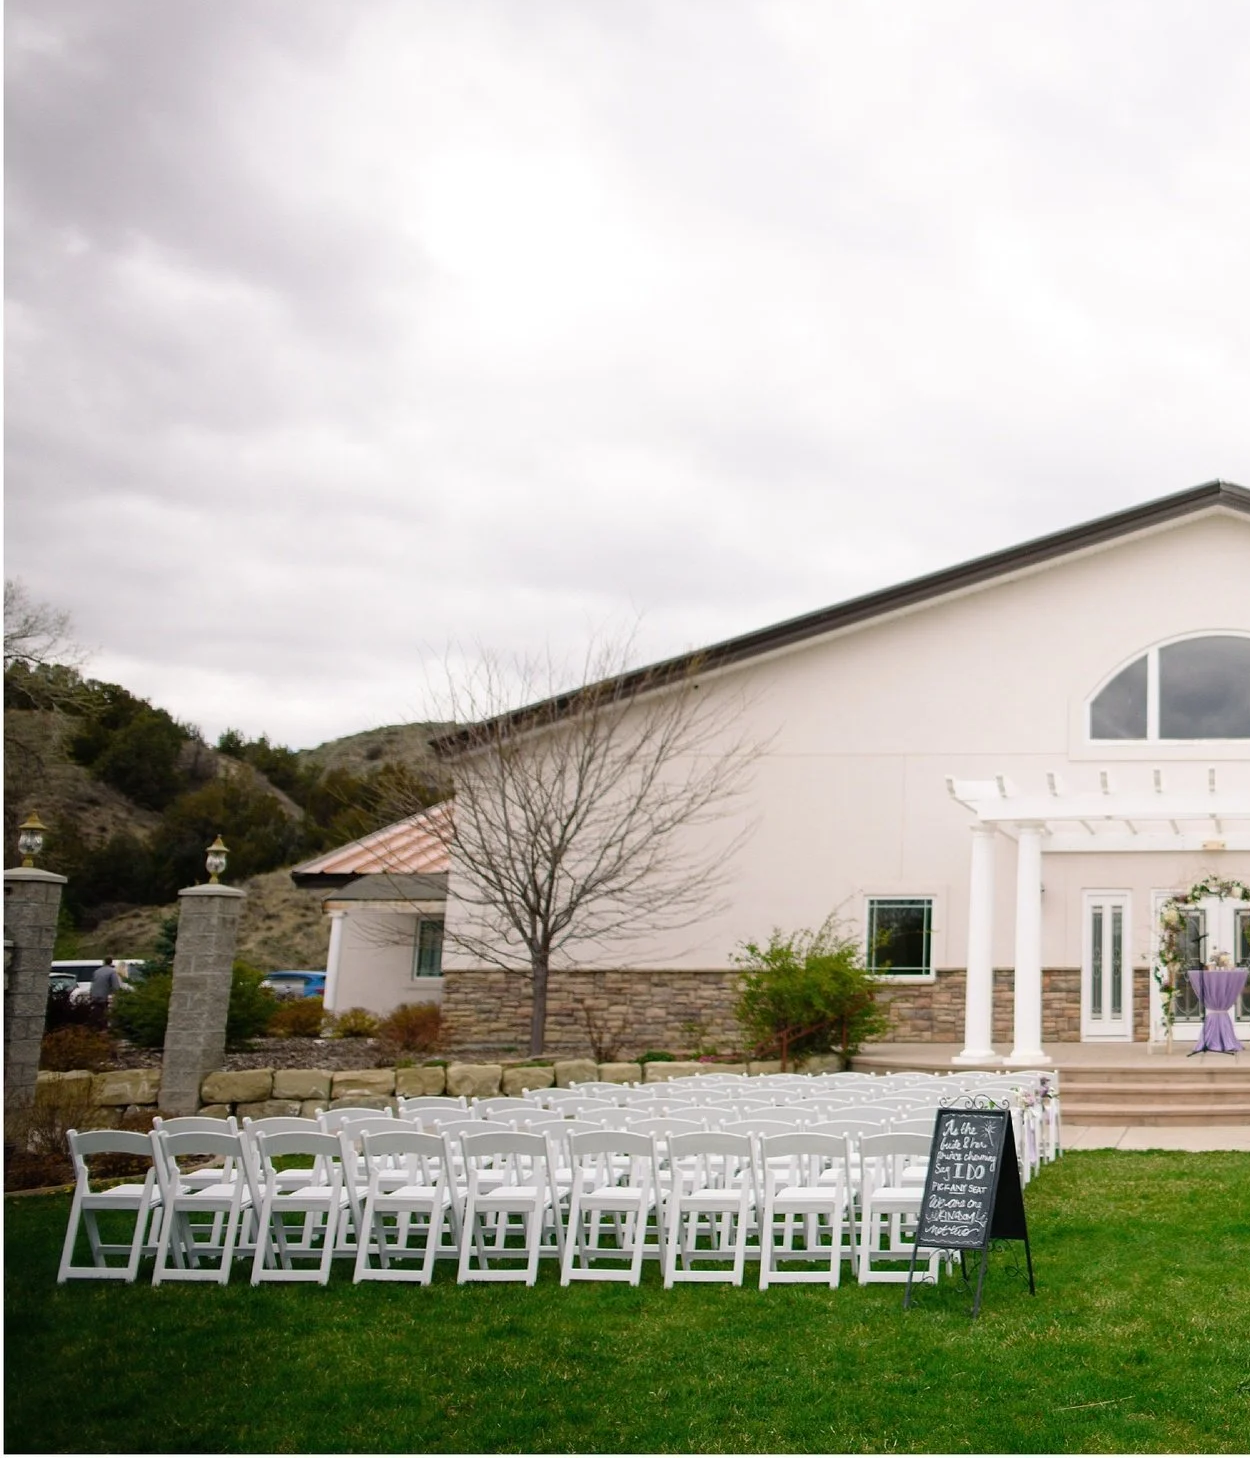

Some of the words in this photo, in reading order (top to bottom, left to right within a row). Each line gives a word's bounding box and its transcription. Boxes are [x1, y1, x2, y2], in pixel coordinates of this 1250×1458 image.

[943, 1119, 958, 1137] As
[960, 1122, 978, 1135] the
[953, 1163, 964, 1179] I
[966, 1163, 985, 1180] DO
[950, 1183, 967, 1192] ANY
[968, 1185, 987, 1194] SEAT
[929, 1194, 946, 1209] We
[945, 1198, 965, 1208] are
